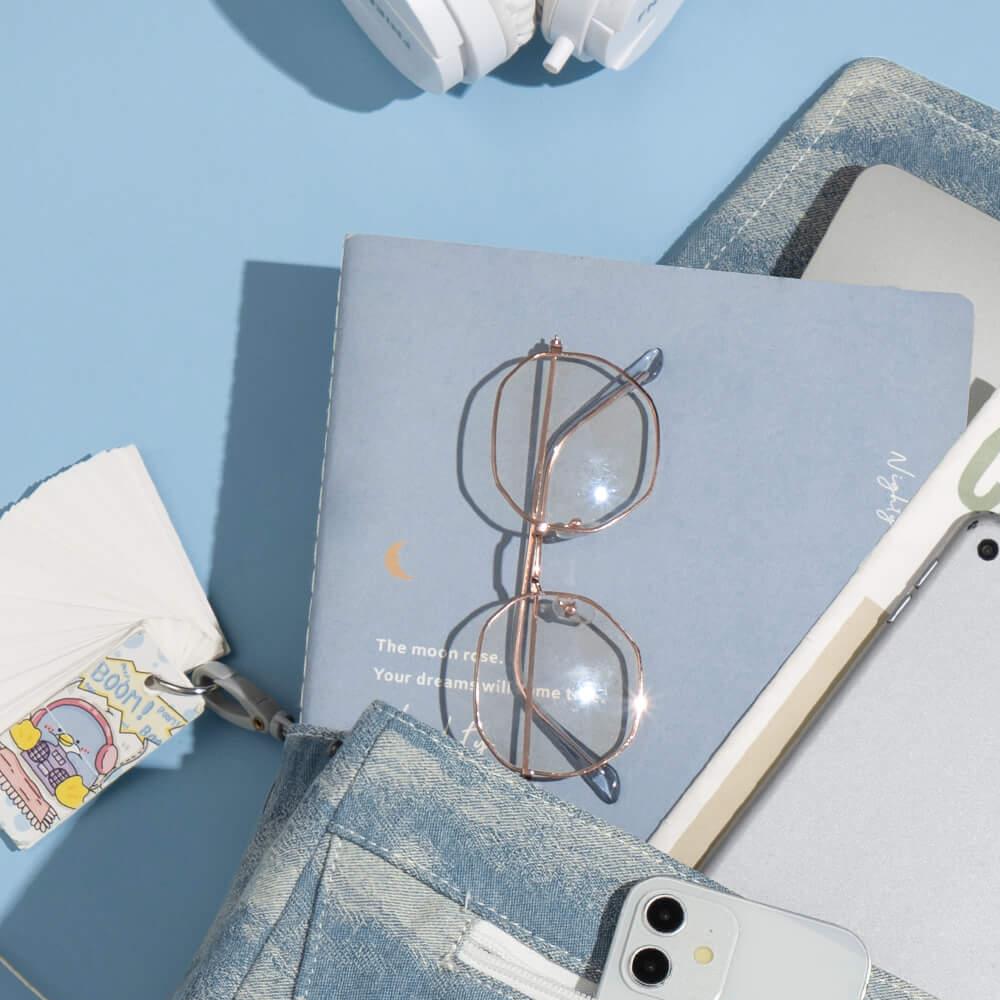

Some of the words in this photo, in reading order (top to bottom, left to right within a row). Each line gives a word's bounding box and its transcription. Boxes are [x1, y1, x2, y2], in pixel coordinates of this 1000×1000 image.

[375, 638, 408, 654] The
[411, 645, 459, 660] moon
[463, 650, 504, 665] rose.
[372, 667, 412, 684] Your
